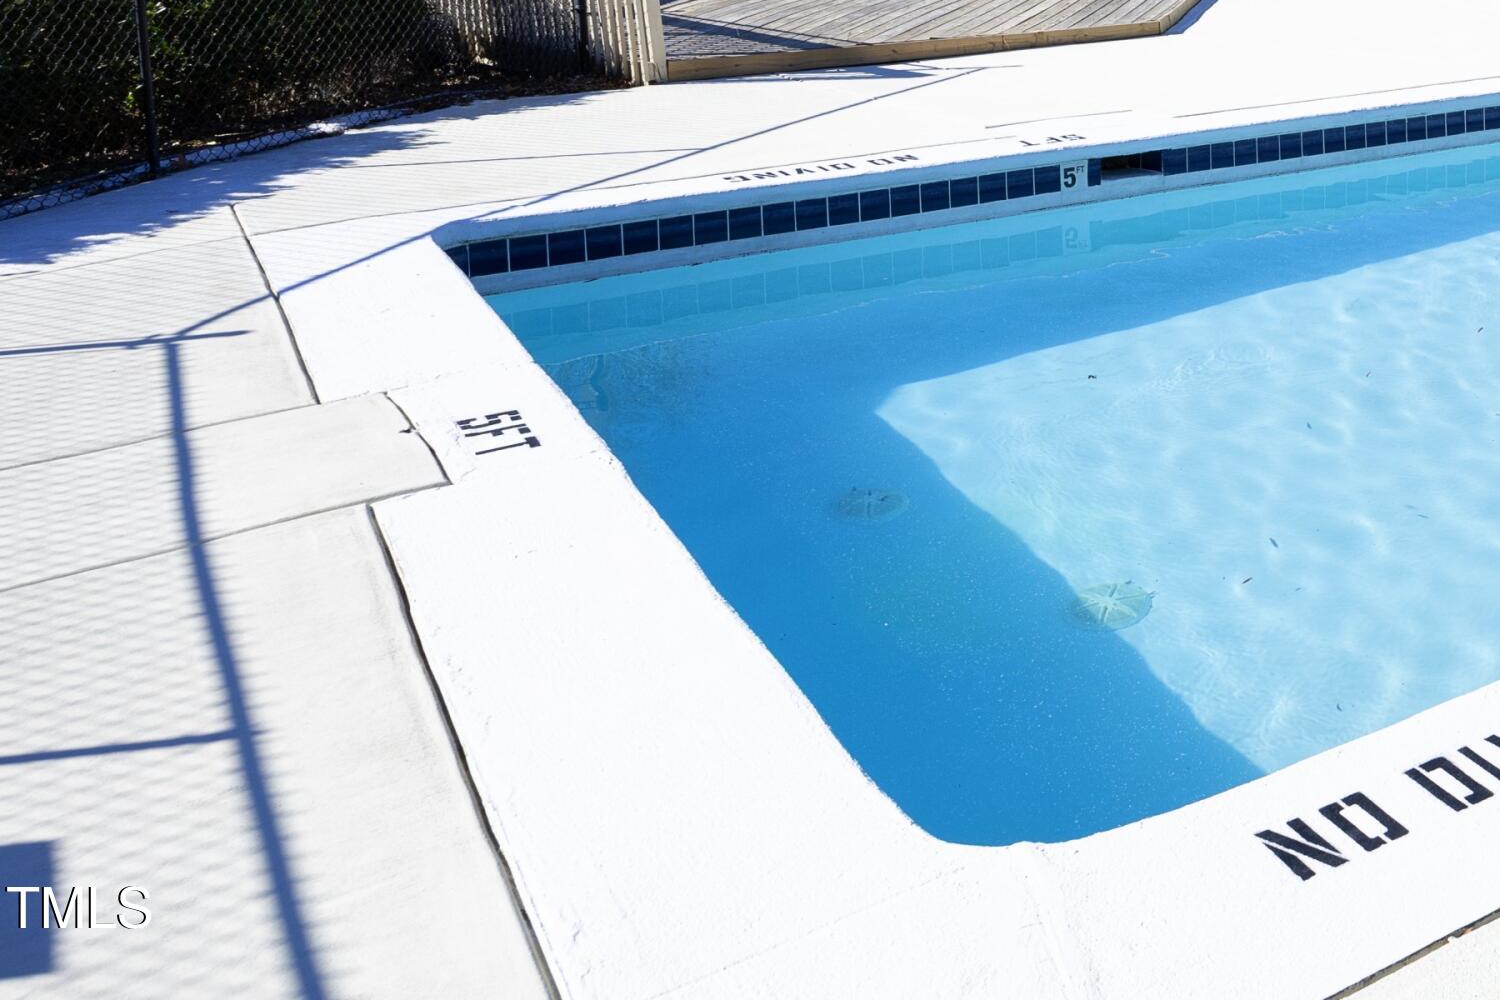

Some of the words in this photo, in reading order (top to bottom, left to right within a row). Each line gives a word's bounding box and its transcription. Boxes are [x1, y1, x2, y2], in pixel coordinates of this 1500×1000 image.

[723, 162, 856, 183] DIVING
[867, 154, 919, 166] NO
[456, 409, 542, 456] 5FT
[1253, 791, 1410, 882] NO
